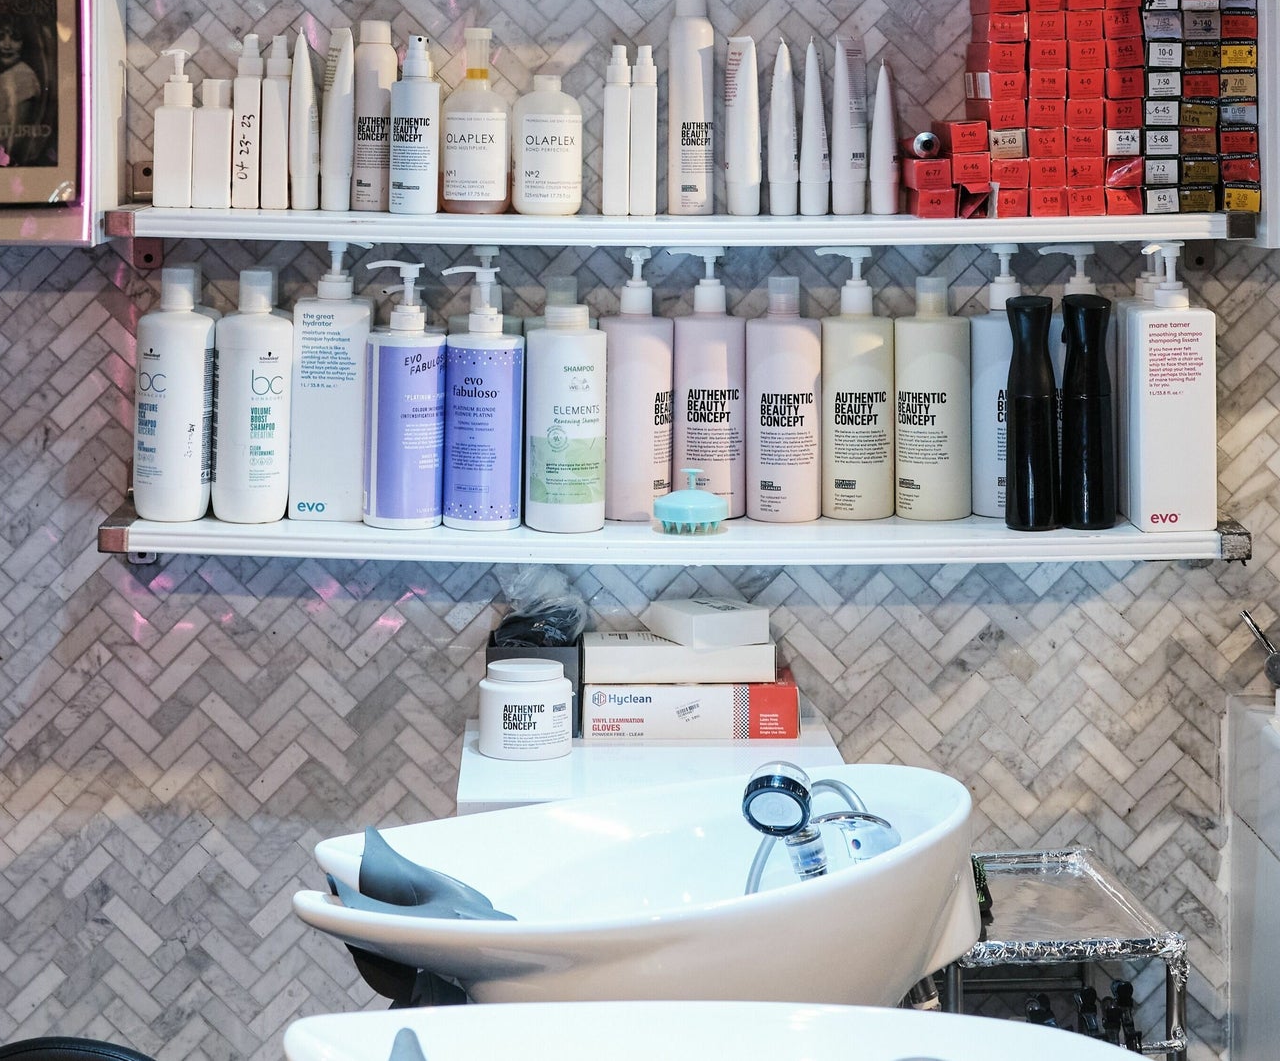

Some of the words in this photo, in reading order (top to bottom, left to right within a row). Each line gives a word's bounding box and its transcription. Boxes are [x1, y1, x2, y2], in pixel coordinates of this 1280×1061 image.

[1192, 19, 1212, 27] 9-140
[1158, 48, 1173, 56] 10-0
[1154, 106, 1170, 114] 6-45
[393, 117, 431, 127] AUTHENTIC
[357, 124, 386, 133] BEAUTY
[393, 125, 419, 134] BEAUTY
[681, 129, 709, 138] BEAUTY
[357, 132, 390, 142] CONCEPT
[393, 133, 423, 143] CONCEPT
[446, 133, 495, 144] OLAPLEX
[525, 135, 575, 146] OLAPLEX
[681, 137, 711, 146] CONCEPT
[1153, 135, 1169, 143] 5-68
[404, 353, 422, 366] EVO
[563, 365, 595, 373] SHAMPOO
[251, 369, 284, 396] bc
[464, 376, 483, 386] evo
[452, 384, 498, 399] fabuloso
[687, 388, 740, 401] AUTHENTIC
[898, 390, 947, 404] AUTHENTIC
[760, 392, 813, 405] AUTHENTIC
[834, 391, 887, 404] AUTHENTIC
[250, 407, 271, 415] VOLUME
[553, 404, 600, 415] ELEMENTS
[687, 400, 726, 412] BEAUTY
[760, 404, 800, 416] BEAUTY
[834, 403, 874, 415] BEAUTY
[898, 401, 930, 415] BEAUTY
[250, 415, 268, 423] BOOST
[687, 411, 731, 423] CONCEPT
[760, 415, 805, 427] CONCEPT
[834, 414, 878, 426] CONCEPT
[898, 413, 937, 426] CONCEPT
[250, 423, 276, 431] SHAMPOO
[297, 501, 325, 513] evo
[1150, 512, 1179, 524] evo
[608, 694, 652, 706] Hyclean
[503, 704, 545, 714] AUTHENTIC
[502, 713, 533, 722] BEAUTY
[502, 721, 537, 731] CONCEPT
[592, 724, 621, 732] GLOVES
